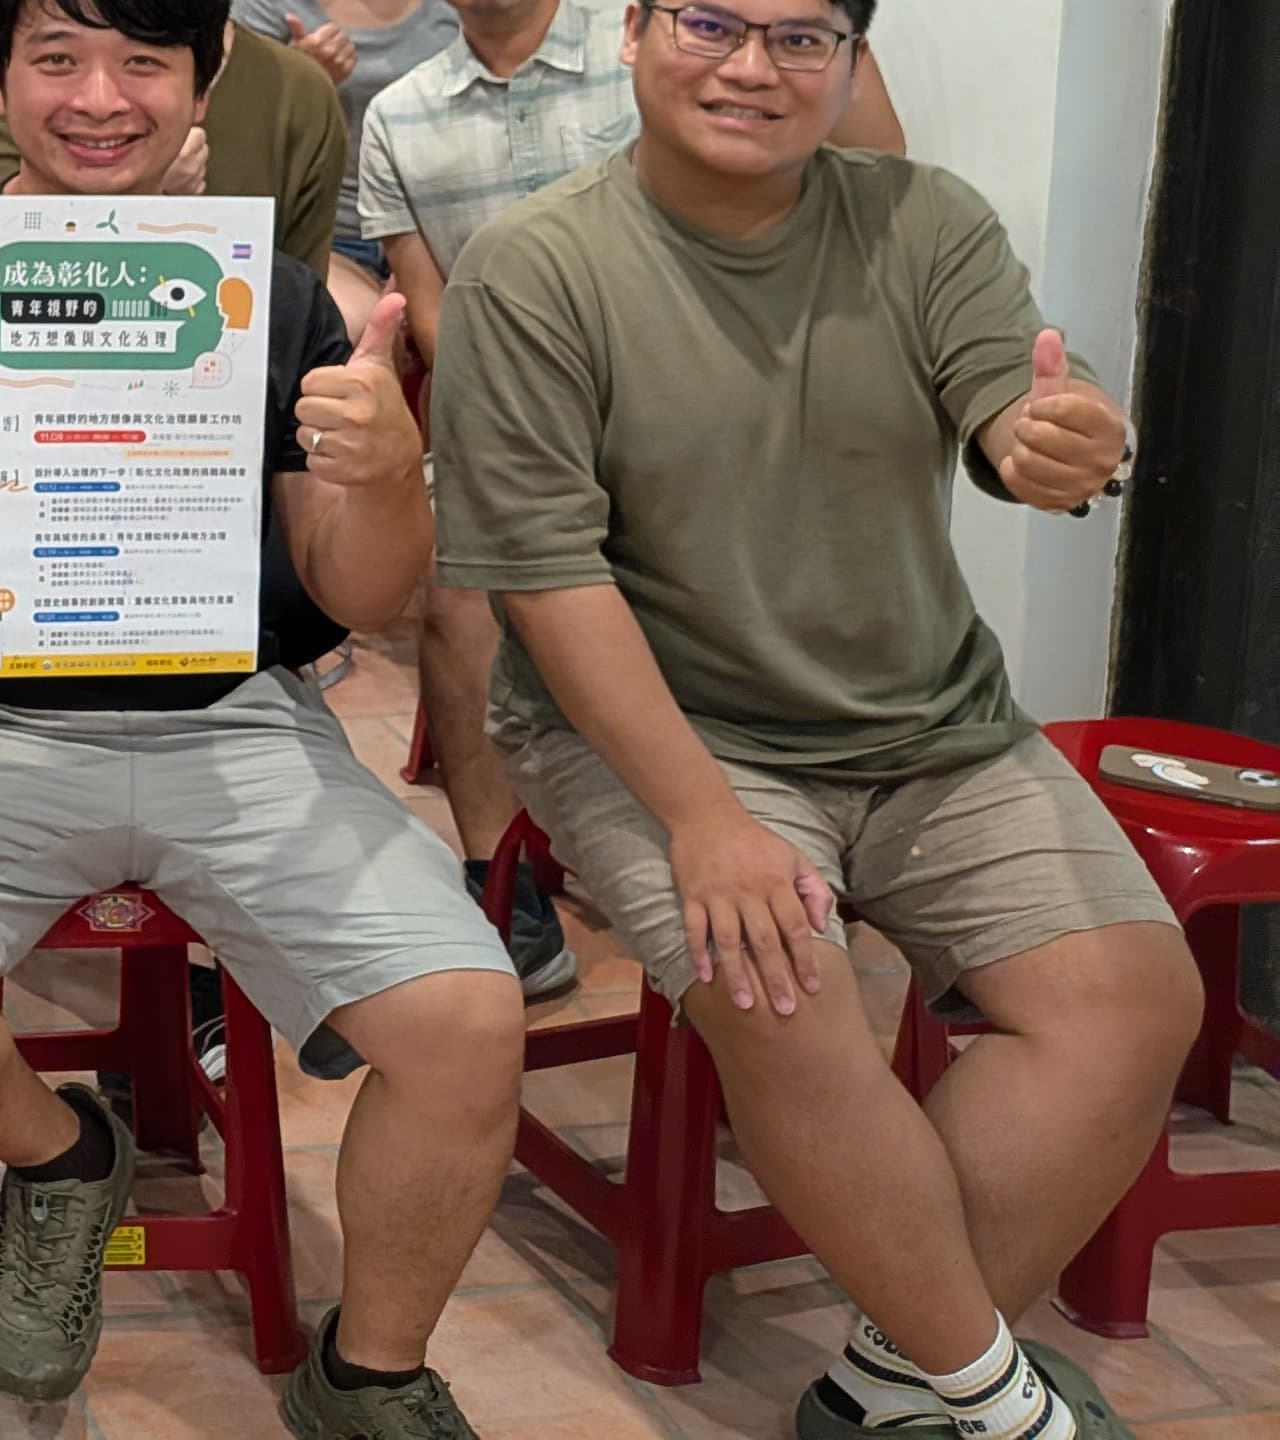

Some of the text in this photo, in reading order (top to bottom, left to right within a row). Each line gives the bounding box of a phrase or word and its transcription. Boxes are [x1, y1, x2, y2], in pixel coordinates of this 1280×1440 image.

[10, 298, 98, 317] 青年視野的
[10, 330, 168, 348] 地方想像與文化治理
